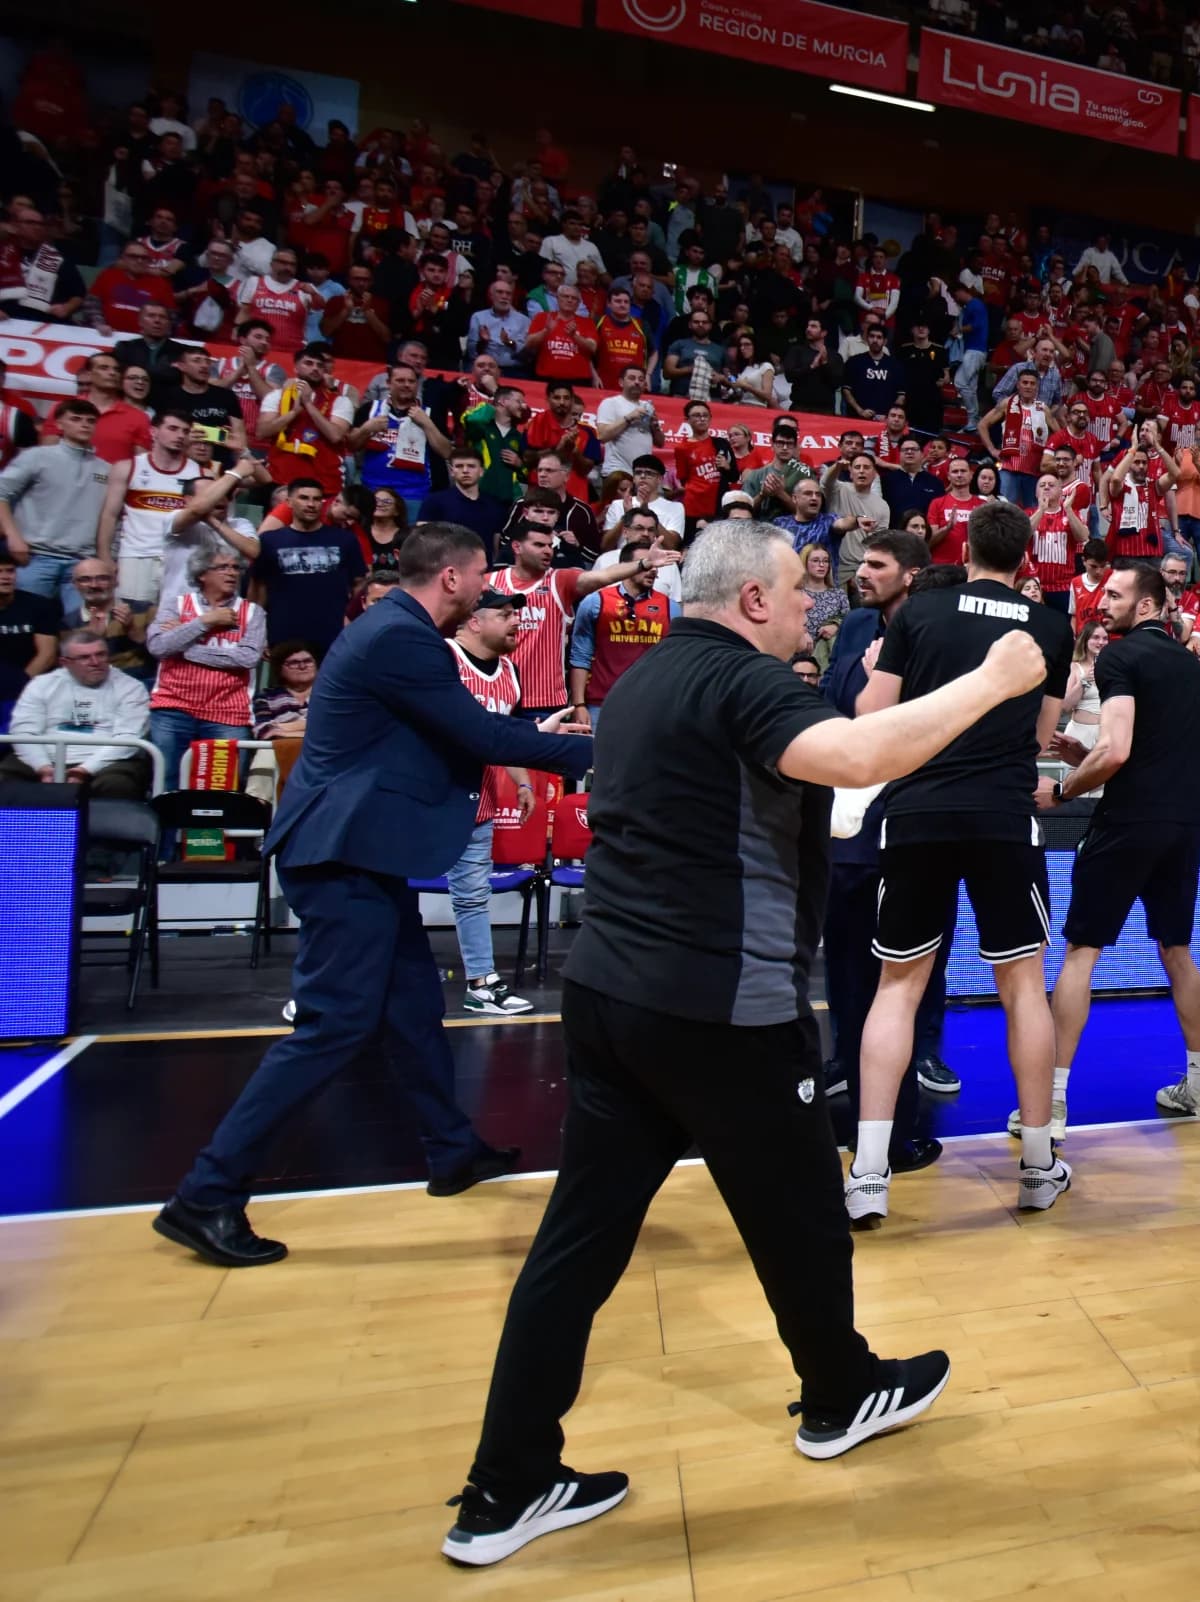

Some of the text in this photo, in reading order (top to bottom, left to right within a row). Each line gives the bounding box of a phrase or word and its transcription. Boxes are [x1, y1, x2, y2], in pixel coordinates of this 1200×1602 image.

[782, 31, 808, 51] DE
[812, 38, 888, 69] MURCIA
[1086, 99, 1099, 111] Tu
[255, 296, 296, 313] UCAM
[866, 368, 889, 381] SW
[958, 594, 1030, 622] IATRIDIS
[610, 619, 663, 635] UCAM
[197, 743, 208, 778] GRANADA
